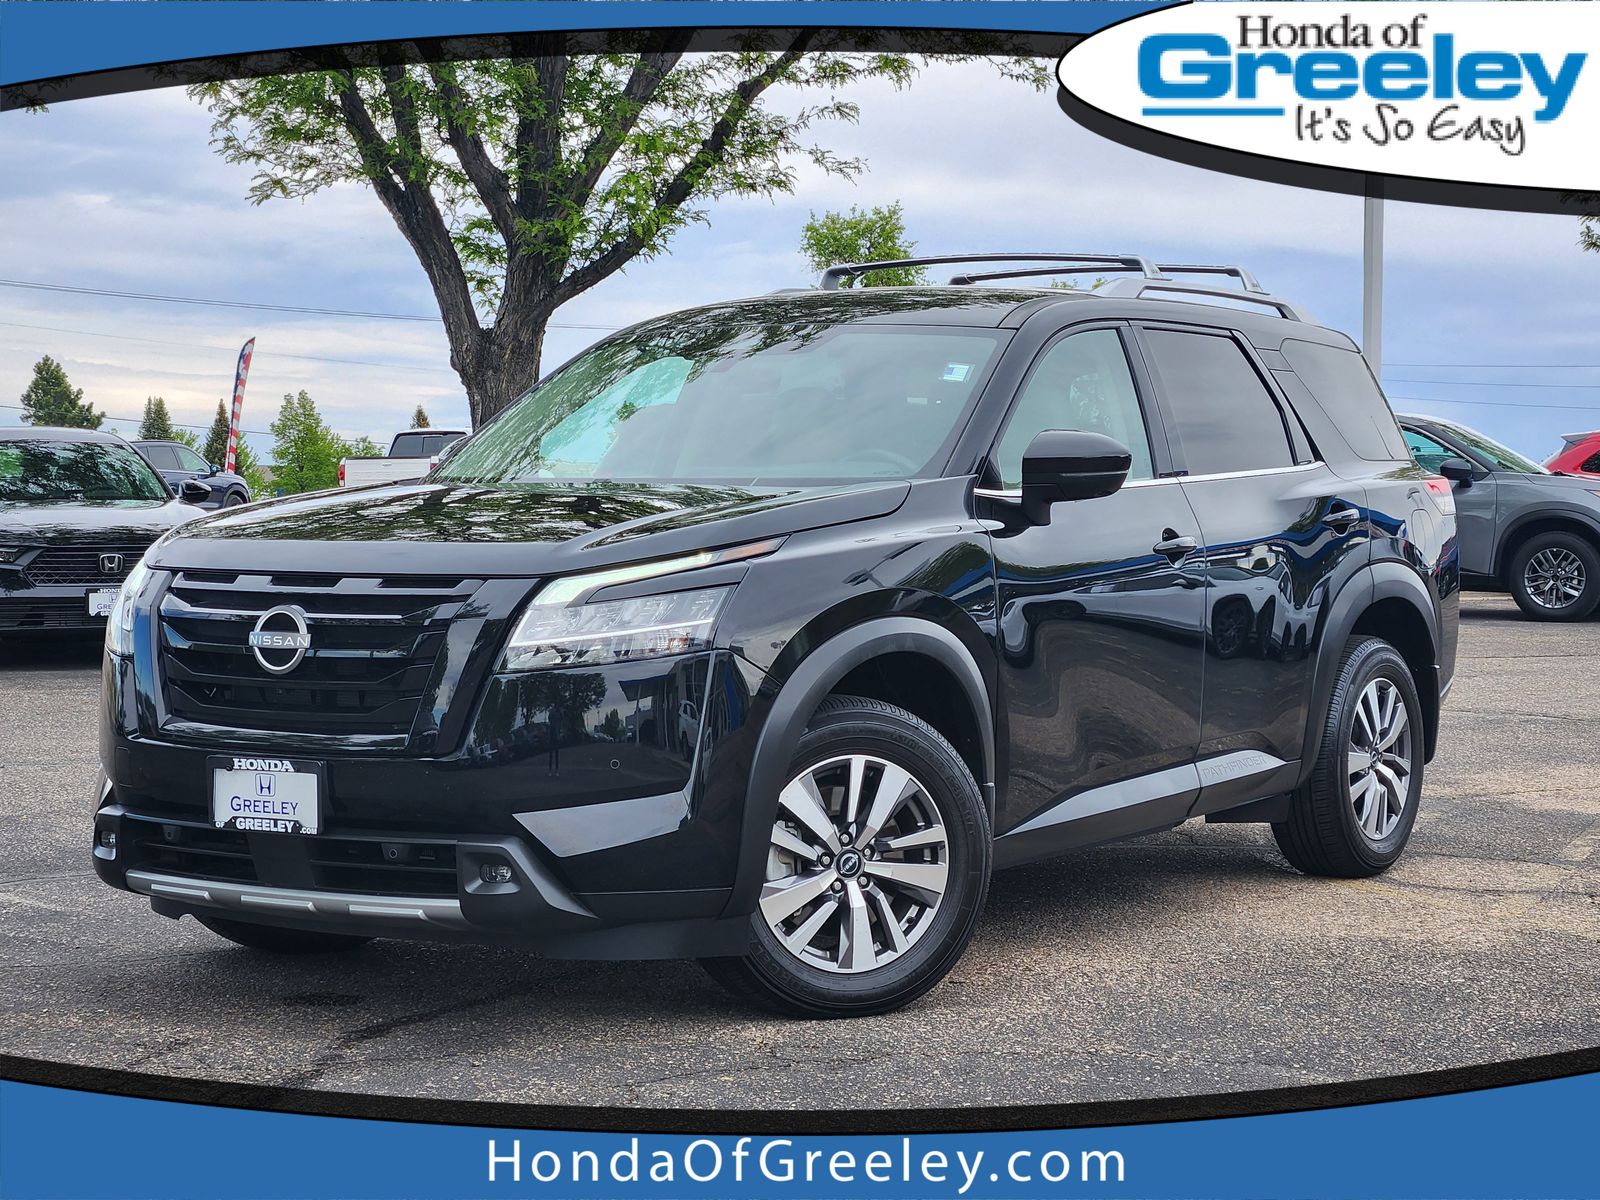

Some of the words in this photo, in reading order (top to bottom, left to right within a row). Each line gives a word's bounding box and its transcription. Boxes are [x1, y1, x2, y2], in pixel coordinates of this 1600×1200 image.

[250, 634, 309, 647] NISSAN
[233, 758, 294, 772] HONDA
[1202, 755, 1268, 778] PATHFINDER
[235, 818, 295, 833] GREELEY
